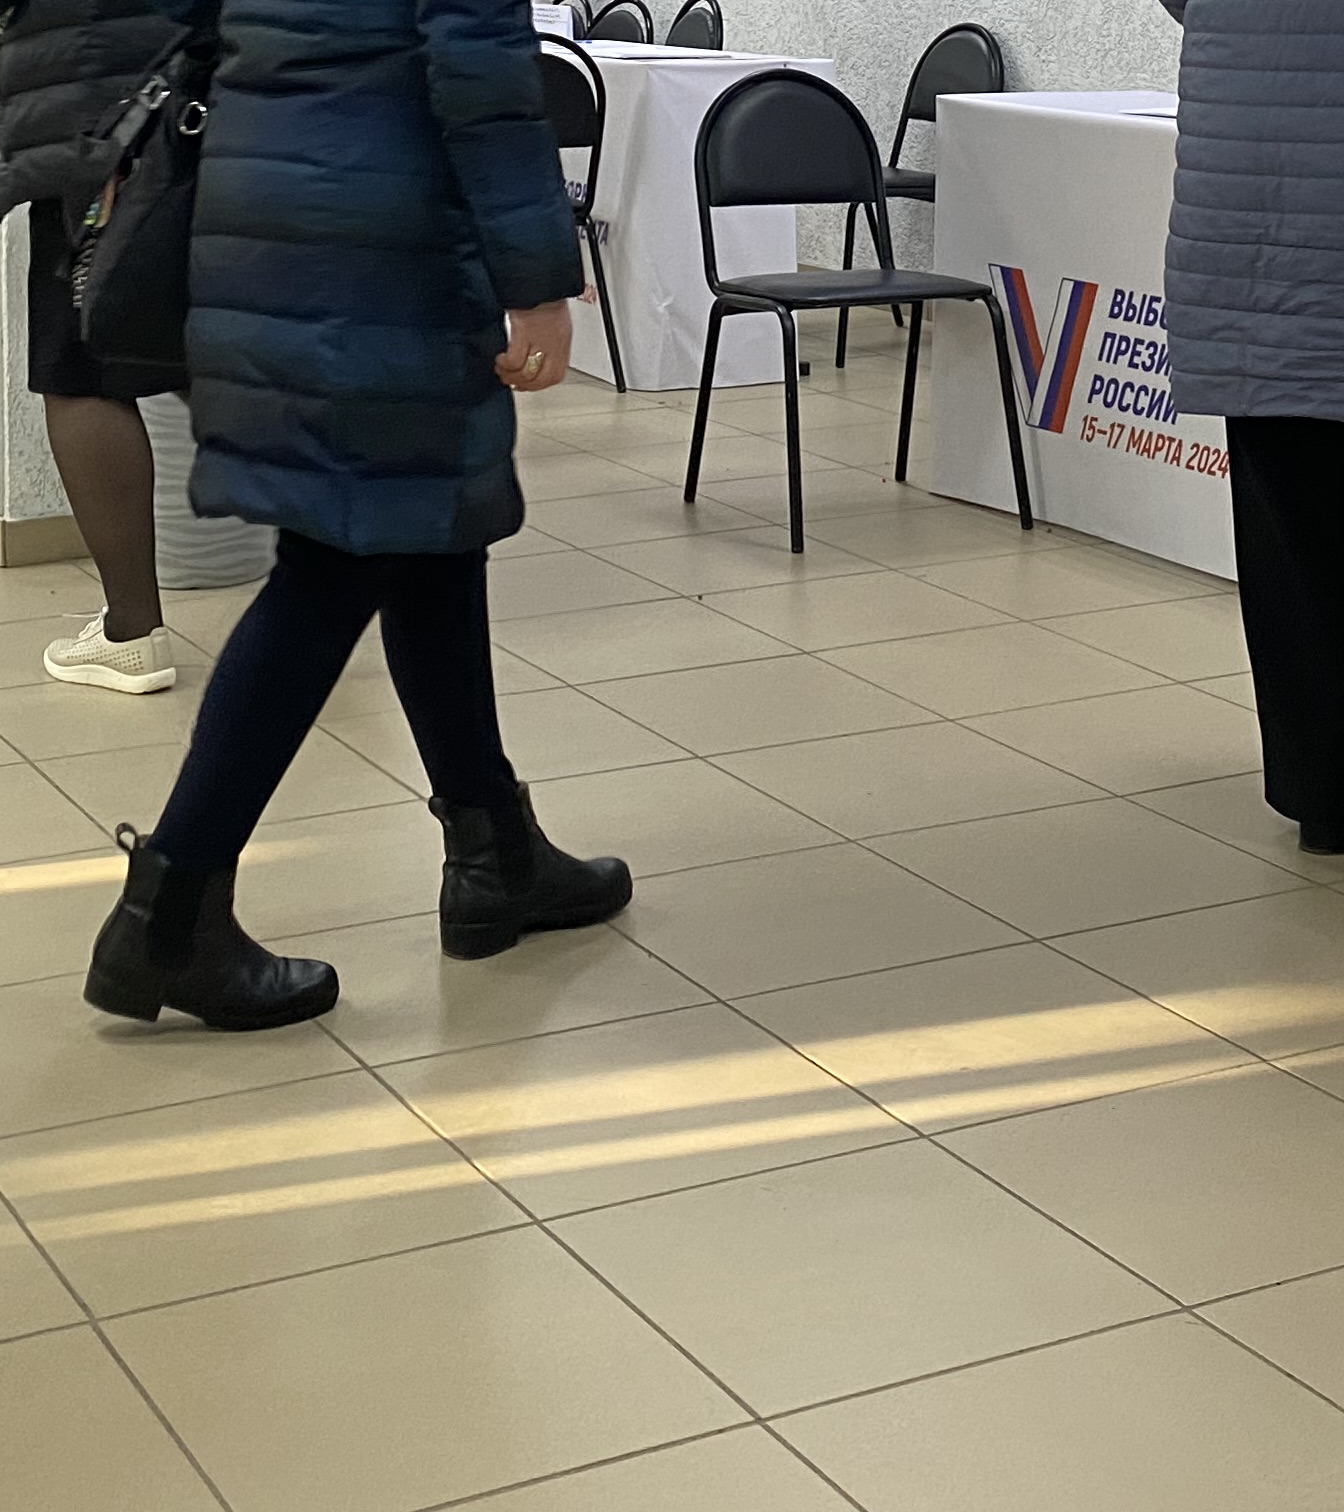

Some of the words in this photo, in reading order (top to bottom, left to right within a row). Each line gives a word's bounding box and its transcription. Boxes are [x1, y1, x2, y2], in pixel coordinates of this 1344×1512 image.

[1098, 331, 1172, 378] ПРЕЗИ
[1125, 426, 1183, 467] МАРТА
[1185, 443, 1230, 479] 2024
